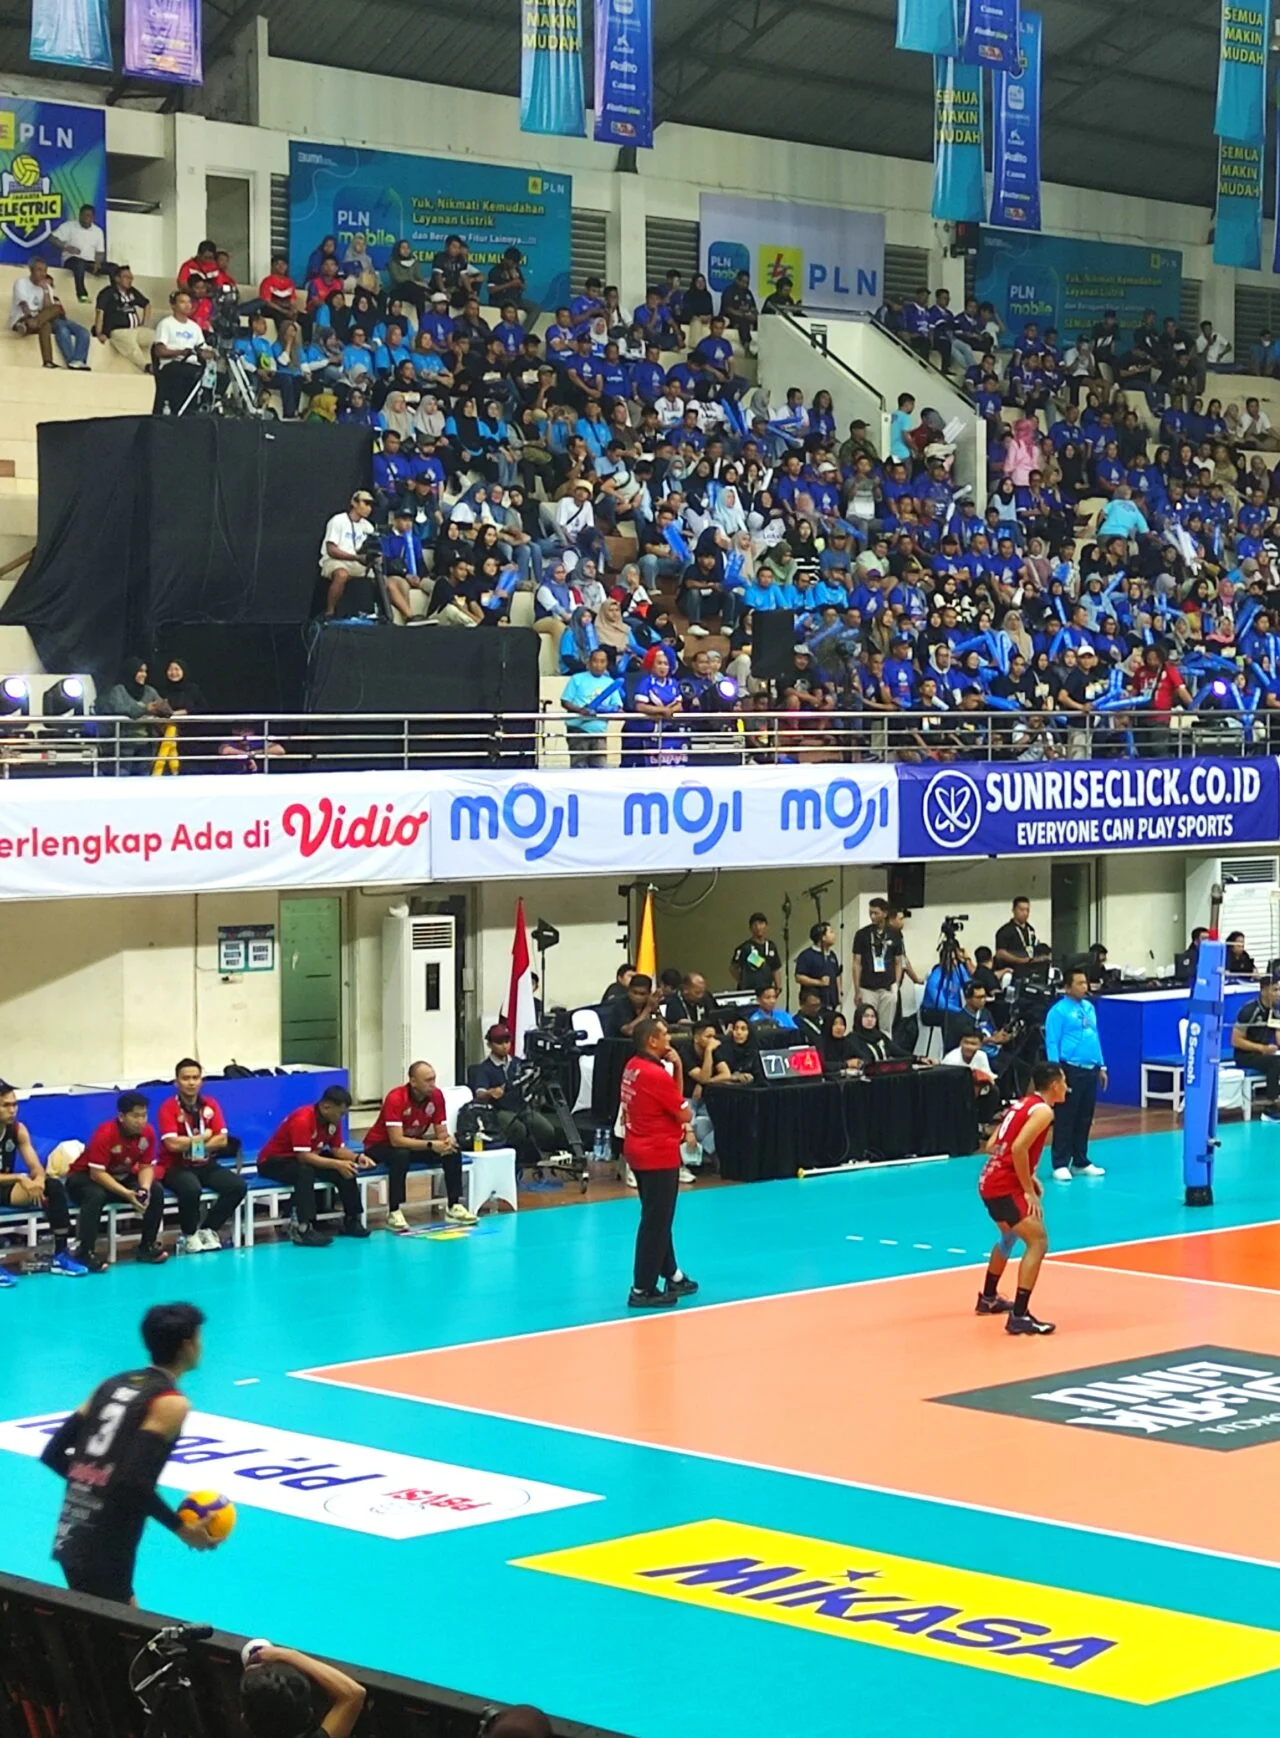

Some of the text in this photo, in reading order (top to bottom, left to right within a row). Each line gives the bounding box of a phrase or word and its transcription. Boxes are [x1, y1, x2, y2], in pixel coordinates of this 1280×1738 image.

[526, 12, 577, 29] MAKIN
[1223, 7, 1264, 27] SEMUA
[522, 33, 582, 51] MUDAH
[1224, 26, 1263, 46] MAKIN
[1221, 46, 1264, 65] MUDAH
[936, 89, 979, 106] SEMUA
[938, 110, 979, 125] MAKIN
[19, 123, 74, 150] PLN
[1221, 146, 1259, 162] SEMUA
[1221, 163, 1258, 180] MAKIN
[543, 181, 565, 195] PLN
[1218, 181, 1261, 198] MUDAH
[411, 197, 545, 214] Yuk, Nikmati Kemudahan
[337, 210, 370, 227] PLN
[412, 213, 495, 228] Layanan Listrik
[411, 231, 428, 241] dan
[710, 255, 732, 268] PLN
[808, 262, 878, 298] PLN
[1009, 284, 1035, 299] PLN
[1009, 299, 1053, 316] mobile
[985, 766, 1261, 812] SUNRISECLICK.CO.ID
[170, 822, 234, 852] Ada
[243, 820, 271, 849] di
[282, 796, 430, 858] Vidio
[1016, 813, 1234, 846] EVERYONE CAN PLAY SPORTS
[1186, 1036, 1199, 1085] Senoh
[1030, 1360, 1275, 1410] LINU
[85, 1403, 127, 1457] 3
[234, 1456, 387, 1493] PP.
[382, 1486, 494, 1512] PBVSI
[633, 1556, 1119, 1672] MIKASA
